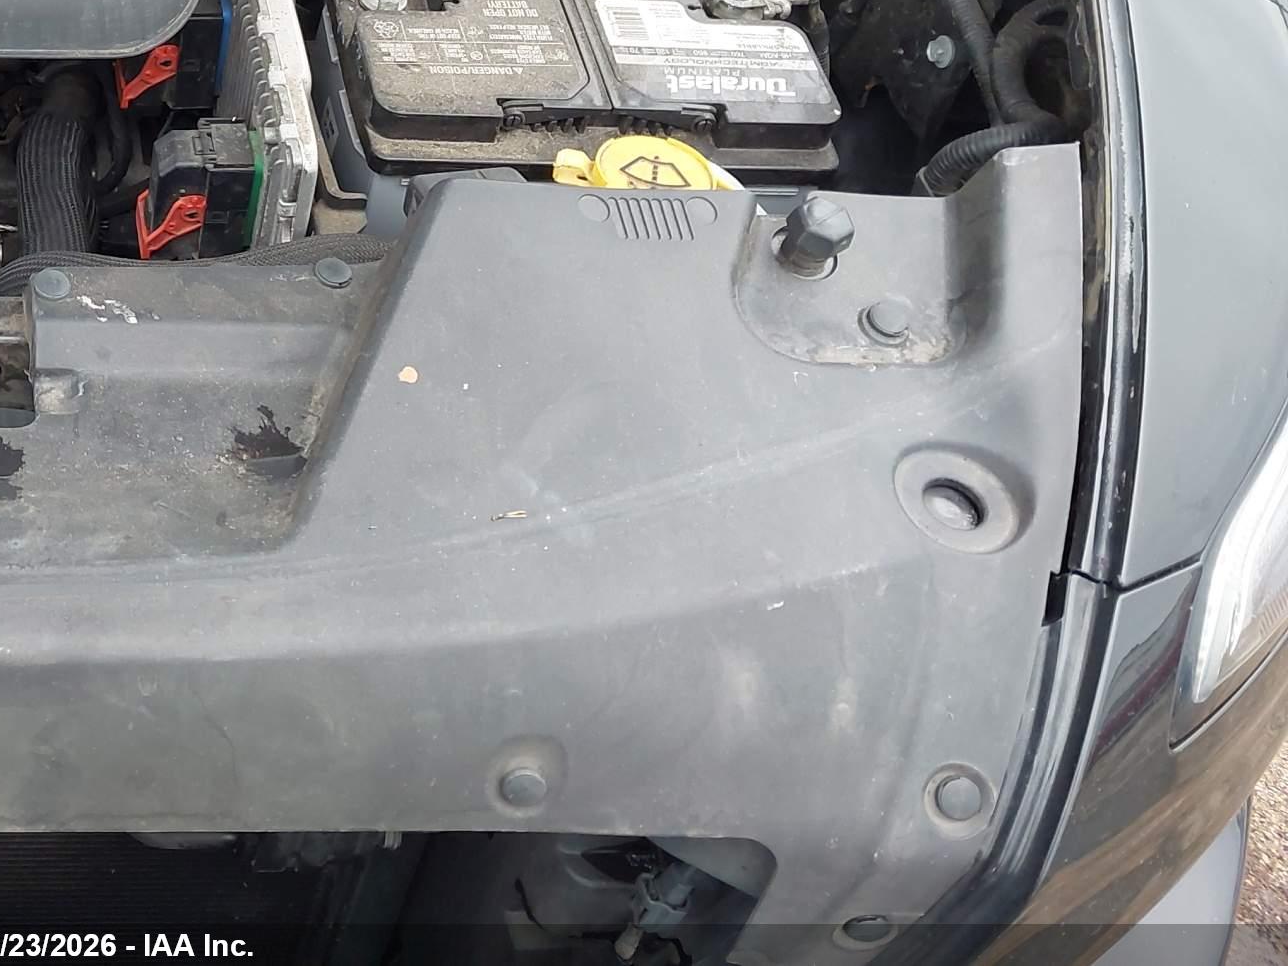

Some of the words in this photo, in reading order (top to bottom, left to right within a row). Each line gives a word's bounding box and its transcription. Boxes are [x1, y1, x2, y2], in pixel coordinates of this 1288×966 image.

[482, 8, 506, 17] OPEN
[508, 8, 526, 17] NOT
[663, 57, 746, 67] TECHNOLOGY
[664, 66, 741, 77] PLATINUM
[665, 74, 796, 97] Duralast
